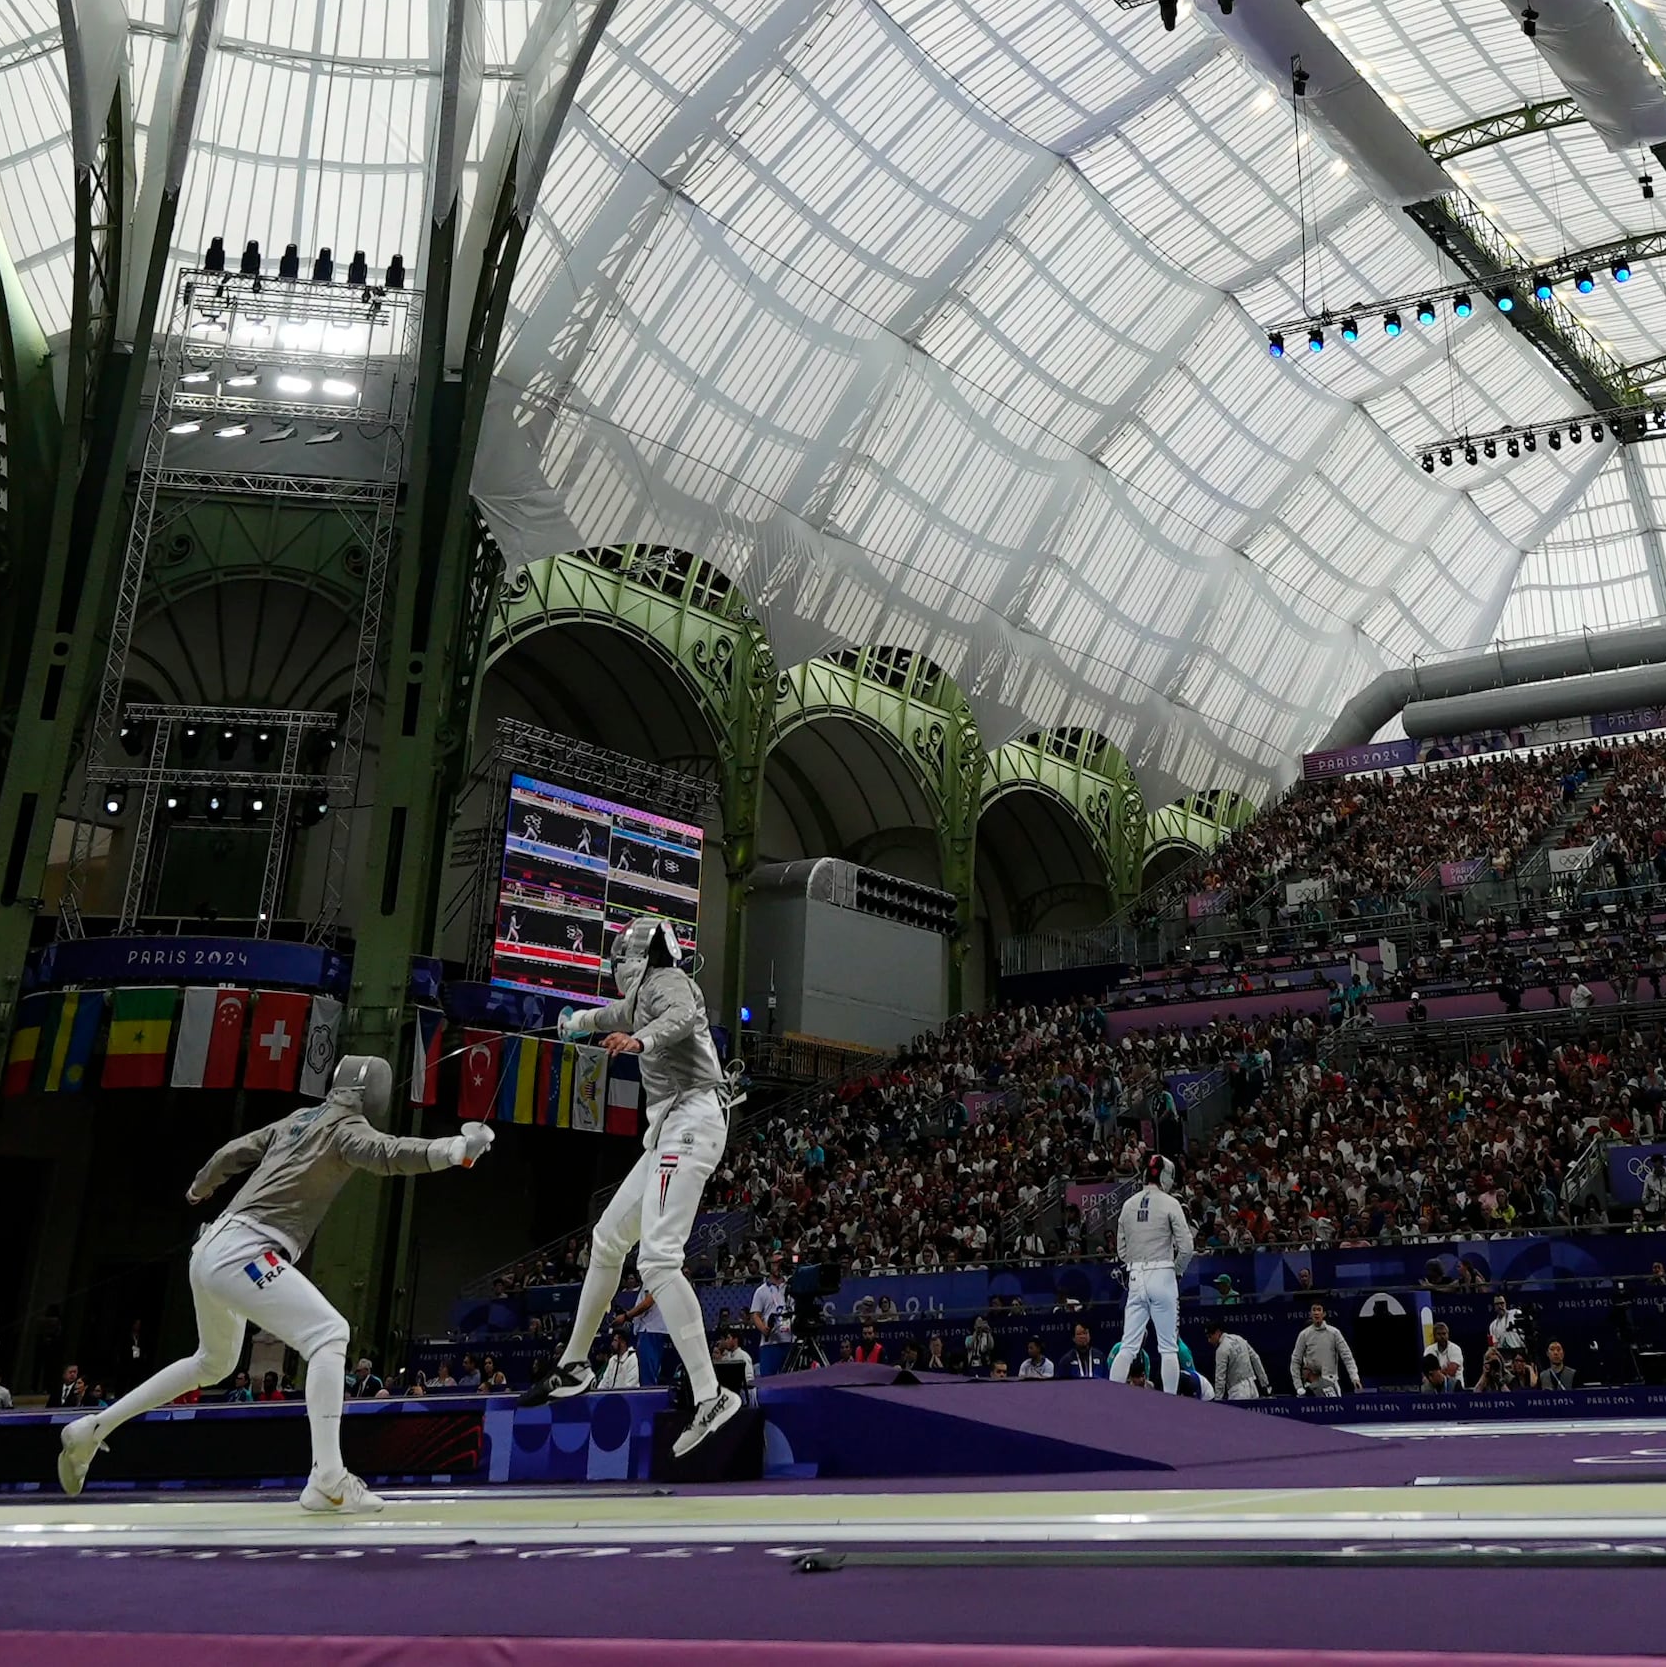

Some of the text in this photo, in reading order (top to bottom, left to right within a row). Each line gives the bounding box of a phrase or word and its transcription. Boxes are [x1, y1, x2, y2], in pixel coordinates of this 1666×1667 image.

[1318, 749, 1400, 771] PARIS 2024
[127, 950, 248, 966] PARIS 2024
[1081, 1193, 1119, 1207] PARIS
[256, 1265, 286, 1290] FRA
